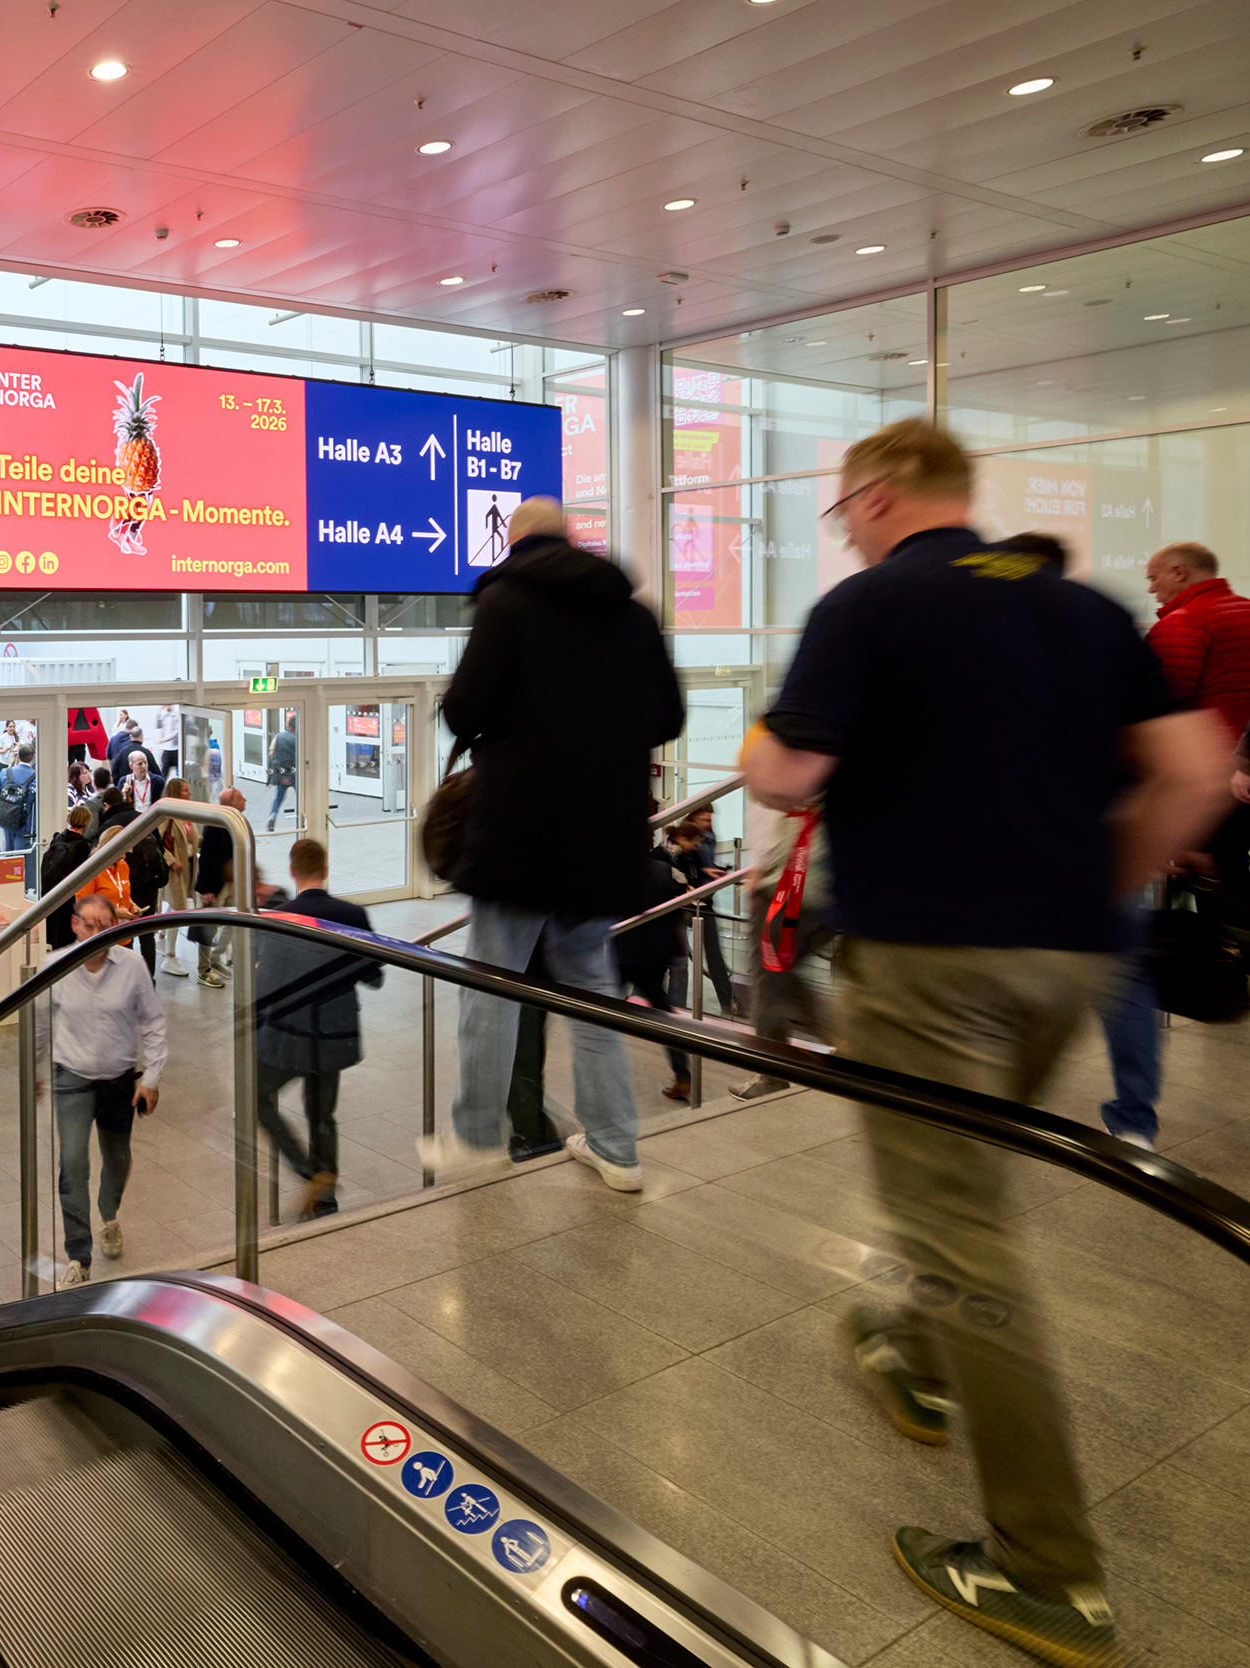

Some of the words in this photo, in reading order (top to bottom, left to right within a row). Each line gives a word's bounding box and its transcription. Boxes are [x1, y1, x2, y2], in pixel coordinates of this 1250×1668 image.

[219, 394, 240, 410] 13.
[256, 398, 287, 414] 17.3.
[250, 414, 288, 431] 2026
[318, 436, 370, 463] Halle
[374, 442, 402, 465] A3
[467, 429, 512, 453] Halle
[60, 458, 126, 486] deine
[467, 456, 486, 478] B1
[500, 458, 522, 480] B7
[576, 474, 591, 484] Die
[576, 486, 594, 498] und
[318, 519, 371, 543] Halle
[374, 522, 404, 545] A4
[576, 519, 592, 530] and
[171, 554, 290, 578] internorga.com
